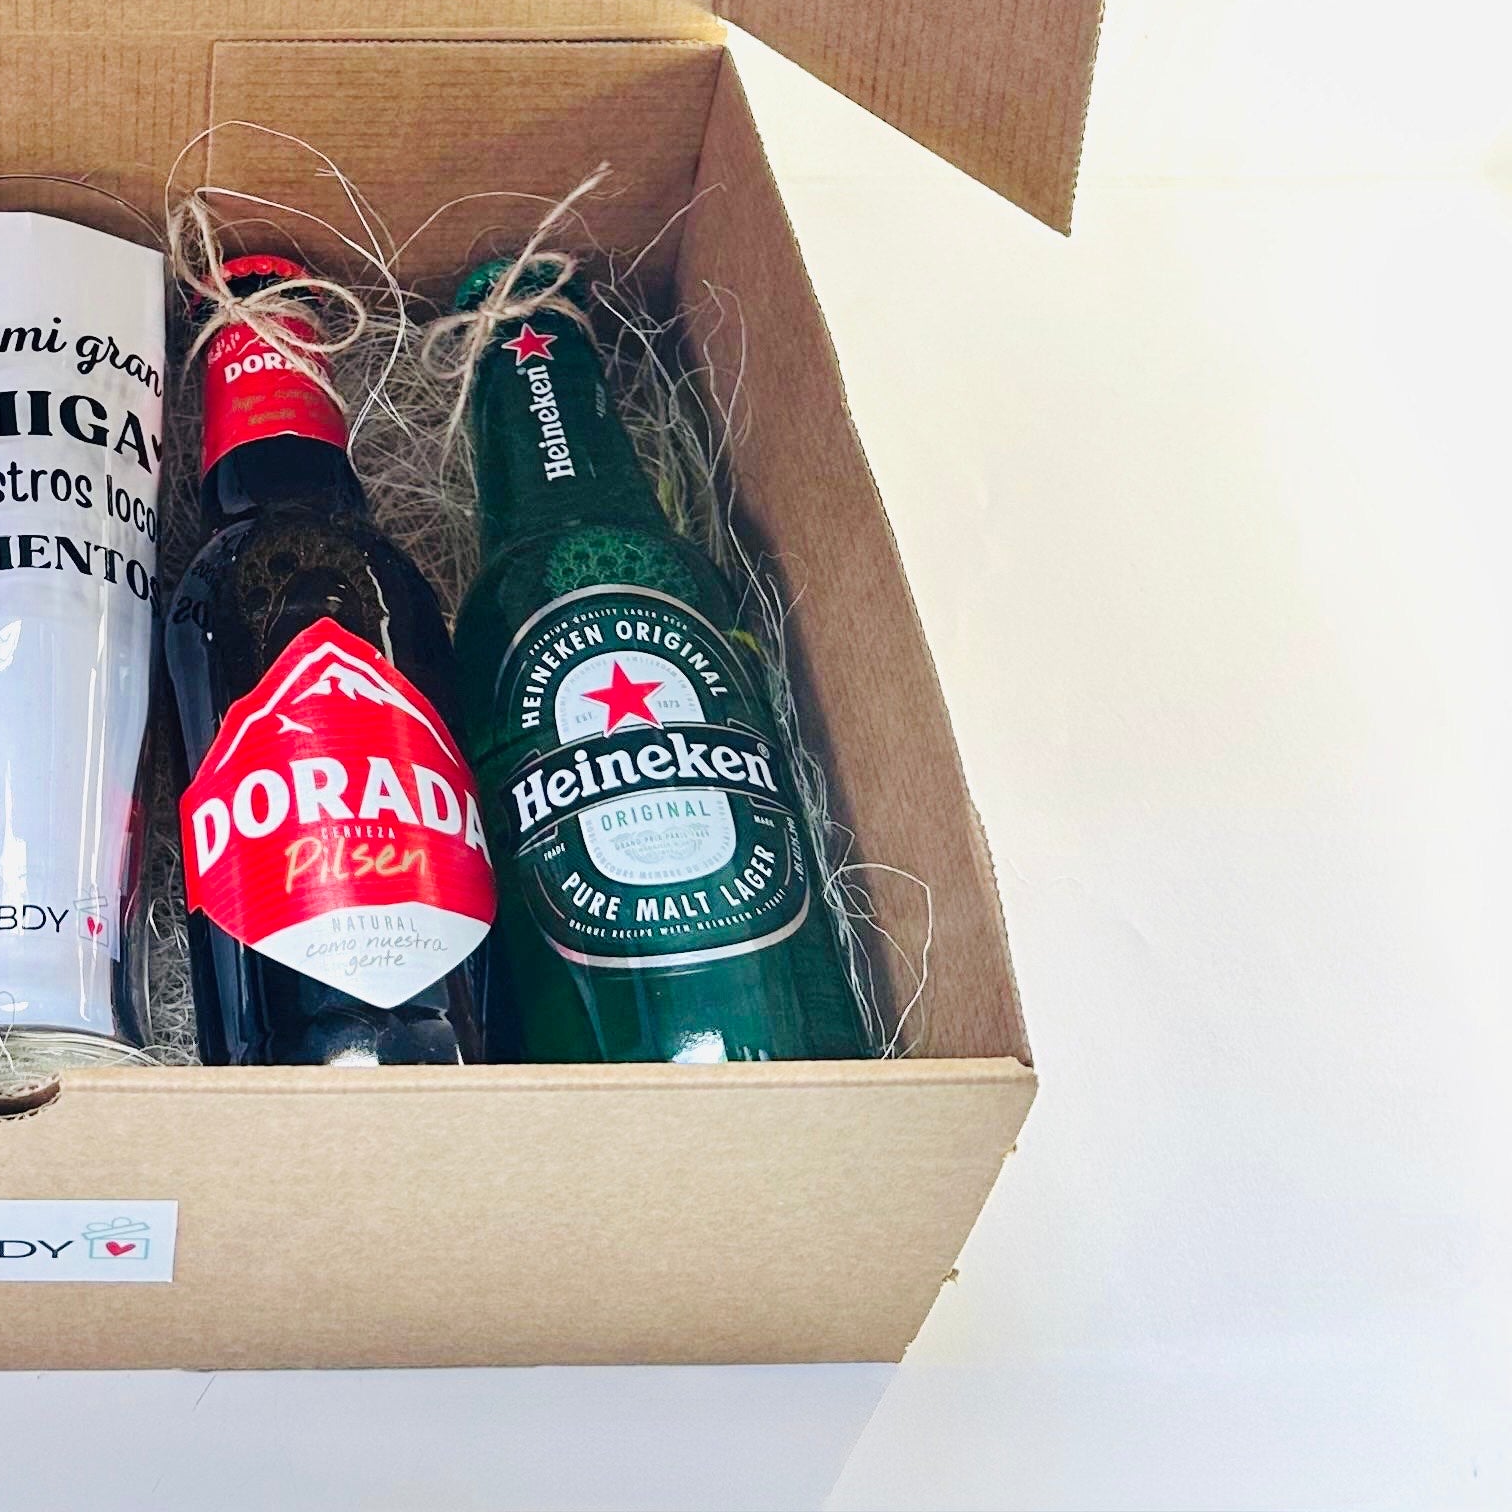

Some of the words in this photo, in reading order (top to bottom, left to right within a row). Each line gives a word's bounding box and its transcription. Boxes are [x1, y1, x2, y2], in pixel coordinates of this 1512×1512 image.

[76, 335, 163, 398] gran
[527, 364, 577, 482] Heineken
[521, 623, 604, 729] HEINEKEN
[615, 620, 729, 698] ORIGINAL
[511, 733, 778, 834] Heineken
[191, 756, 493, 878] DORADA
[321, 824, 397, 841] CERVEZA
[600, 799, 712, 832] ORIGINAL
[284, 835, 427, 895] Pilsen
[561, 871, 622, 921] PURE
[635, 890, 711, 922] MALT
[719, 844, 776, 907] LAGER
[306, 937, 357, 958] como
[366, 932, 449, 952] nuestra
[332, 915, 419, 933] NATURAL
[344, 949, 407, 977] gente
